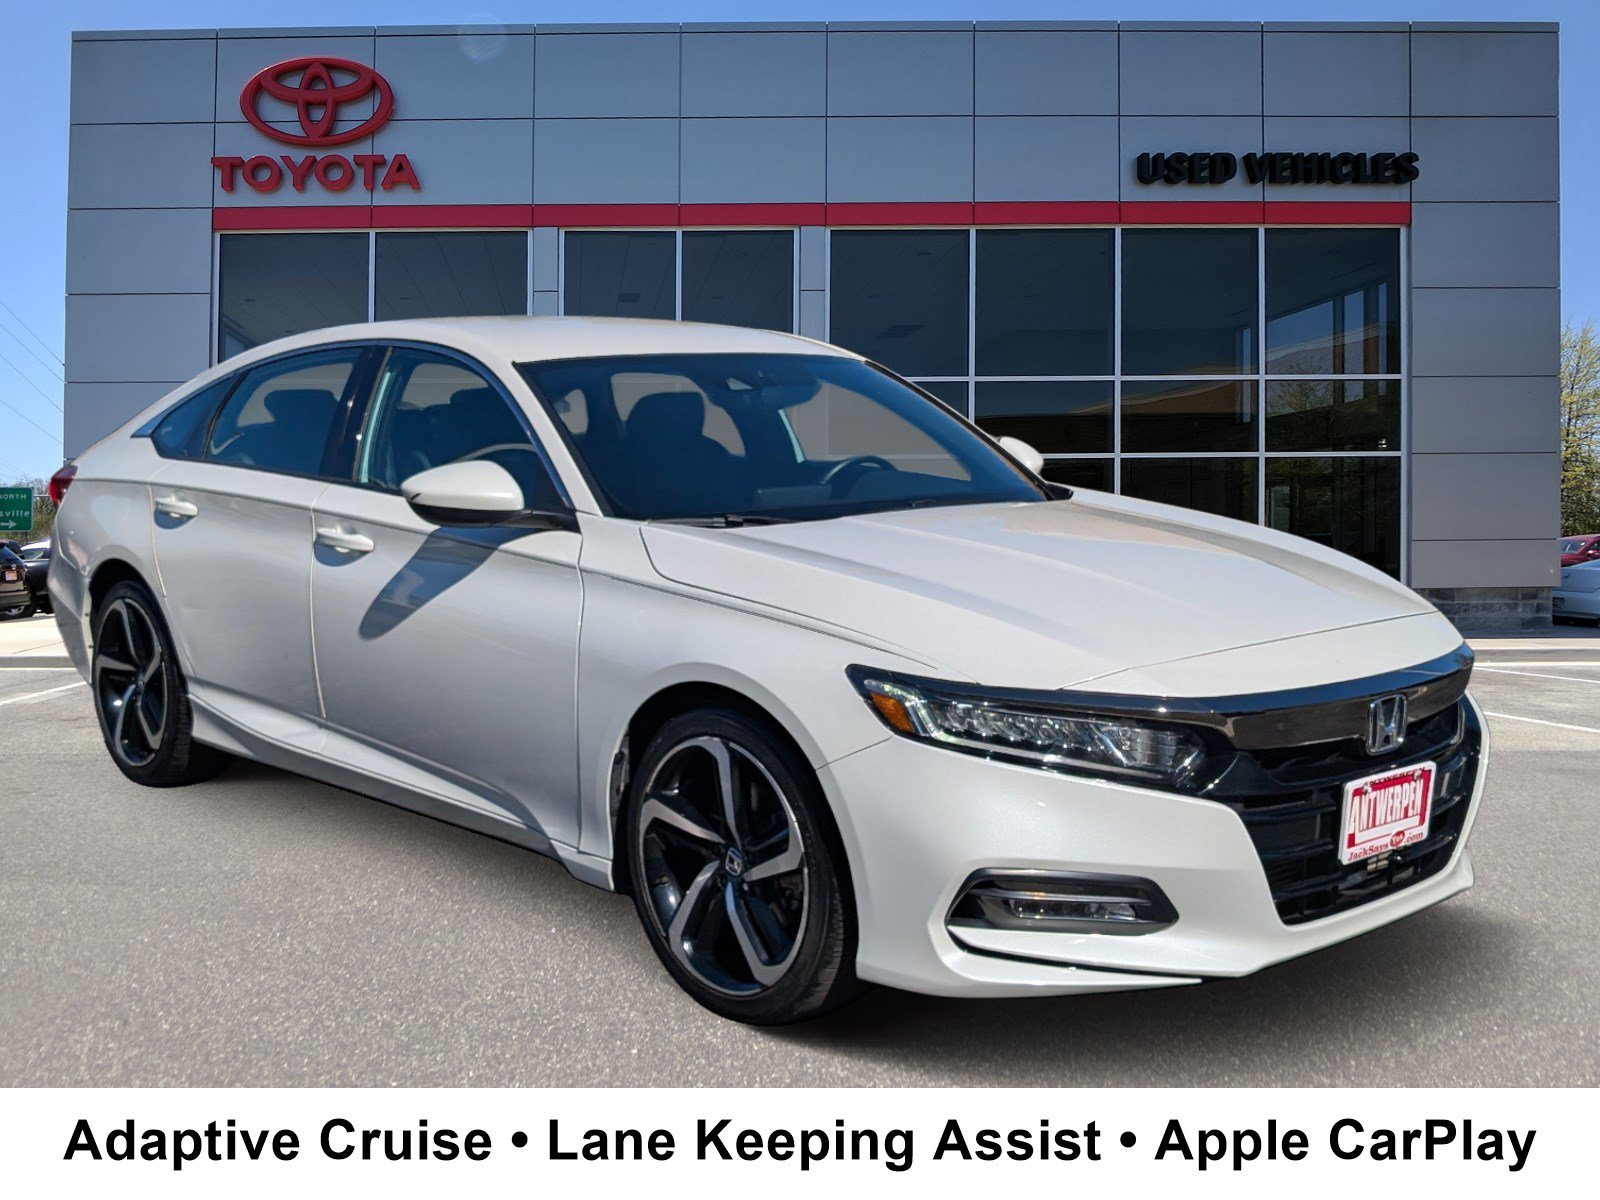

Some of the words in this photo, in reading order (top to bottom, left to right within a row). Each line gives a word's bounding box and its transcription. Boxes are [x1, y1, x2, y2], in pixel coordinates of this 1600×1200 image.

[211, 154, 420, 191] TOYOTA
[1136, 152, 1237, 184] USED
[1242, 151, 1420, 184] VEHICLES
[1349, 778, 1424, 835] ANTWERPEN
